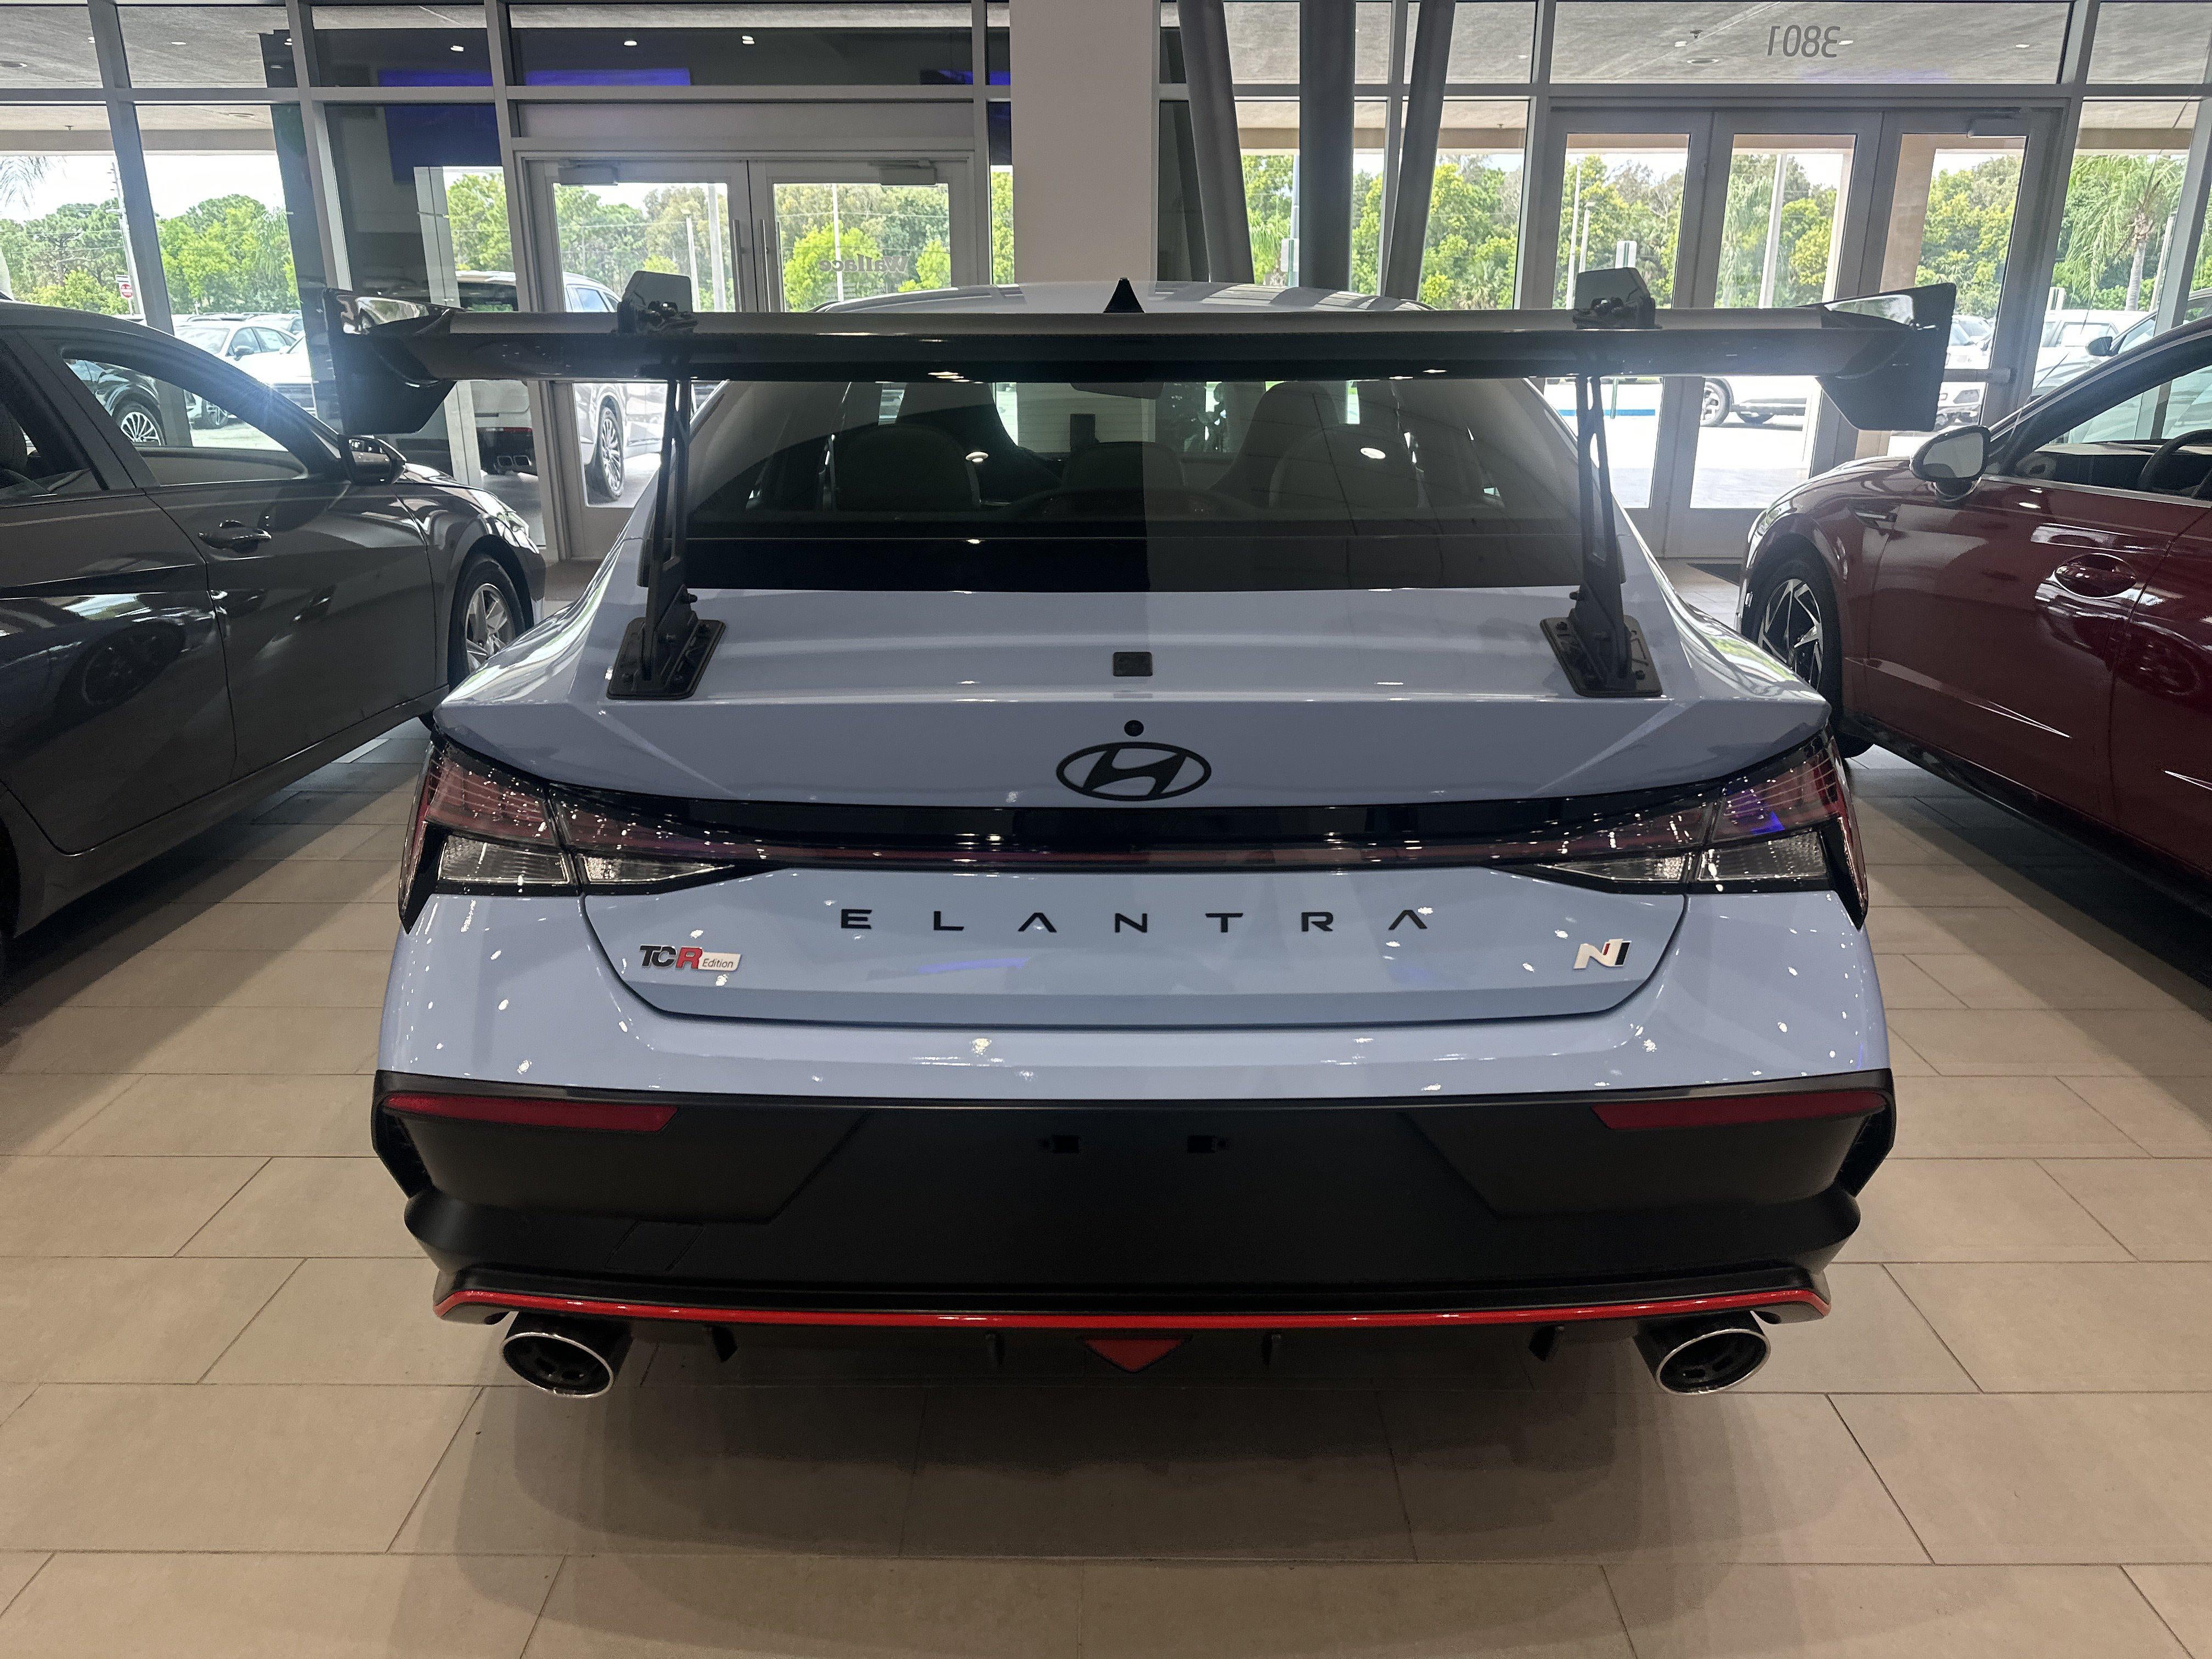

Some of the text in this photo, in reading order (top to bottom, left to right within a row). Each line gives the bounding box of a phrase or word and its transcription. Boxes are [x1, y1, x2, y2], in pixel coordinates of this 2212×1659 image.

[841, 909, 1428, 934] ELANTRA
[639, 945, 734, 969] TCR Edition
